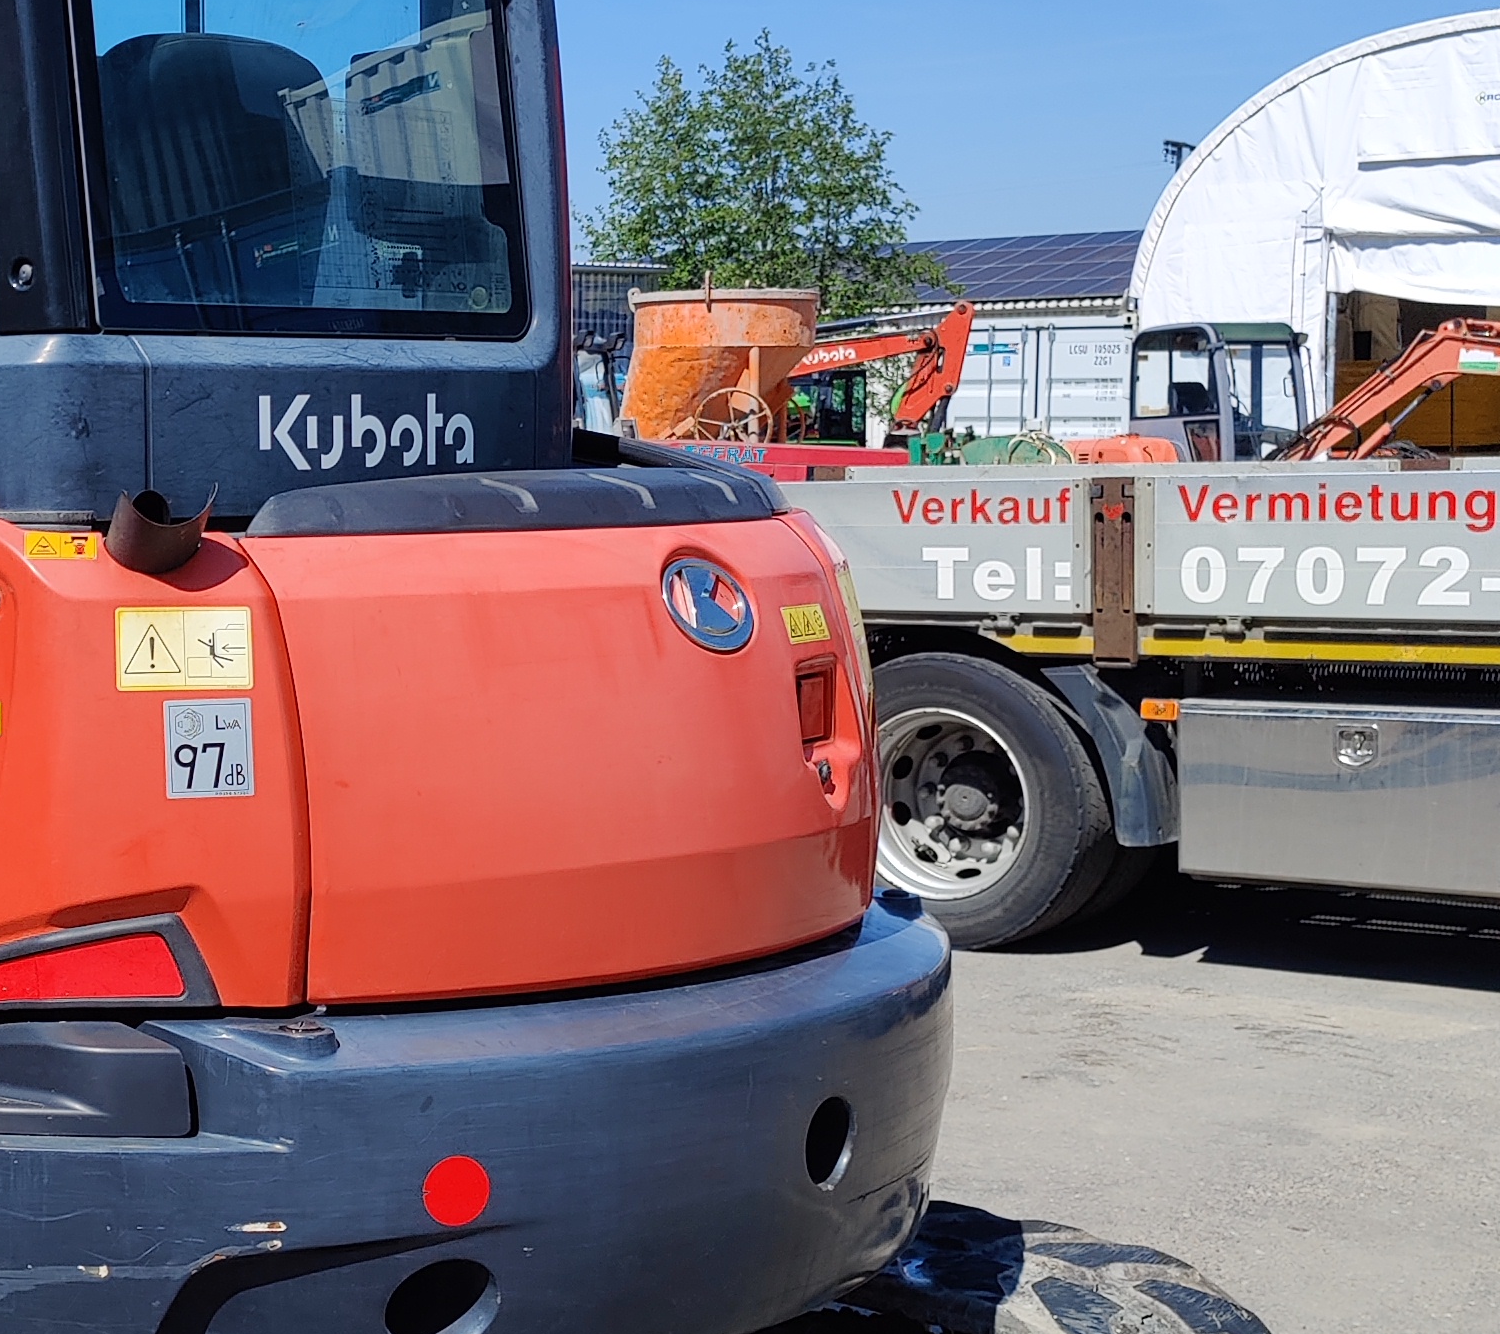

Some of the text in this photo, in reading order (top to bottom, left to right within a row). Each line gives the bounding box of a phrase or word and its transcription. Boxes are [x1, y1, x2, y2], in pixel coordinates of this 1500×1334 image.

[258, 392, 475, 471] Kubota
[891, 482, 1496, 533] Verkauf Vermietung
[921, 545, 1500, 606] Tel: 07072-
[174, 742, 226, 789] 97
